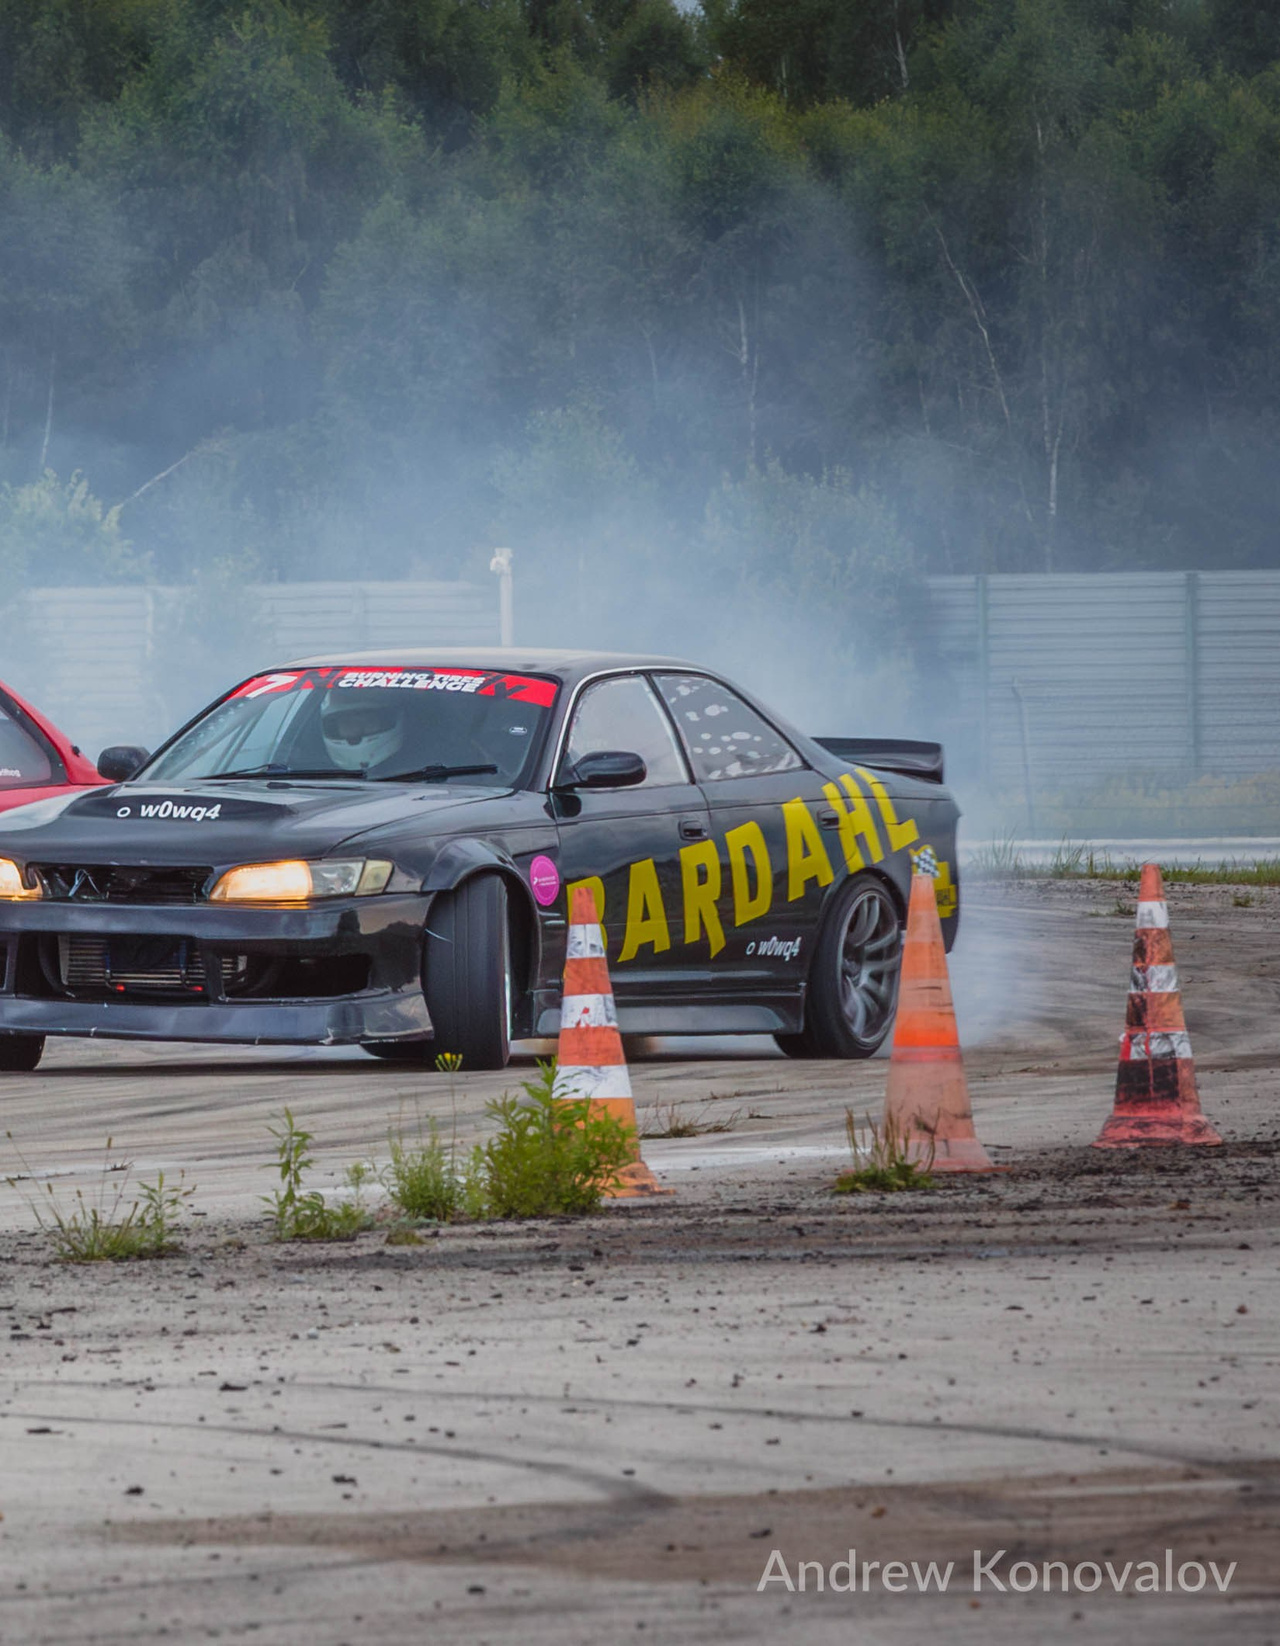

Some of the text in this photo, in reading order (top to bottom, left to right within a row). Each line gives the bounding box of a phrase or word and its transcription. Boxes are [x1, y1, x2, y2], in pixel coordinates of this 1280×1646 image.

[343, 672, 487, 684] BURNING TIRES
[245, 674, 298, 699] 7
[338, 679, 484, 693] CHALLENGE
